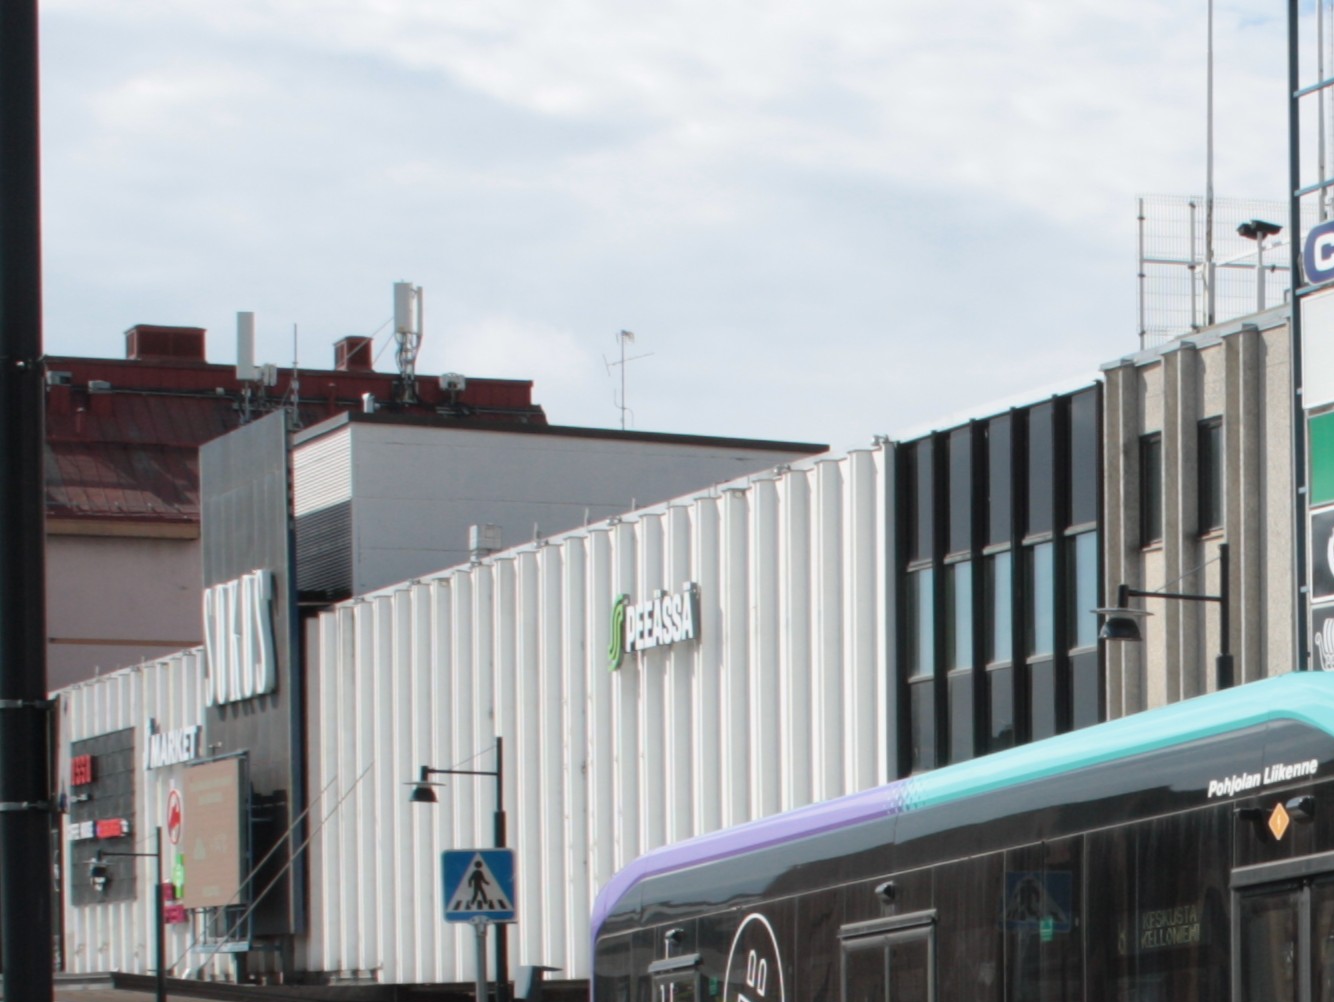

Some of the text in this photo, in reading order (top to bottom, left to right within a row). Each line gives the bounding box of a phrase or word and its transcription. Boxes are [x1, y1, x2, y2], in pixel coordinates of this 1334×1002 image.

[625, 581, 695, 653] PEEÄSSÄ
[149, 725, 198, 769] MARKET
[1207, 759, 1318, 798] Pohjolan Liikenne
